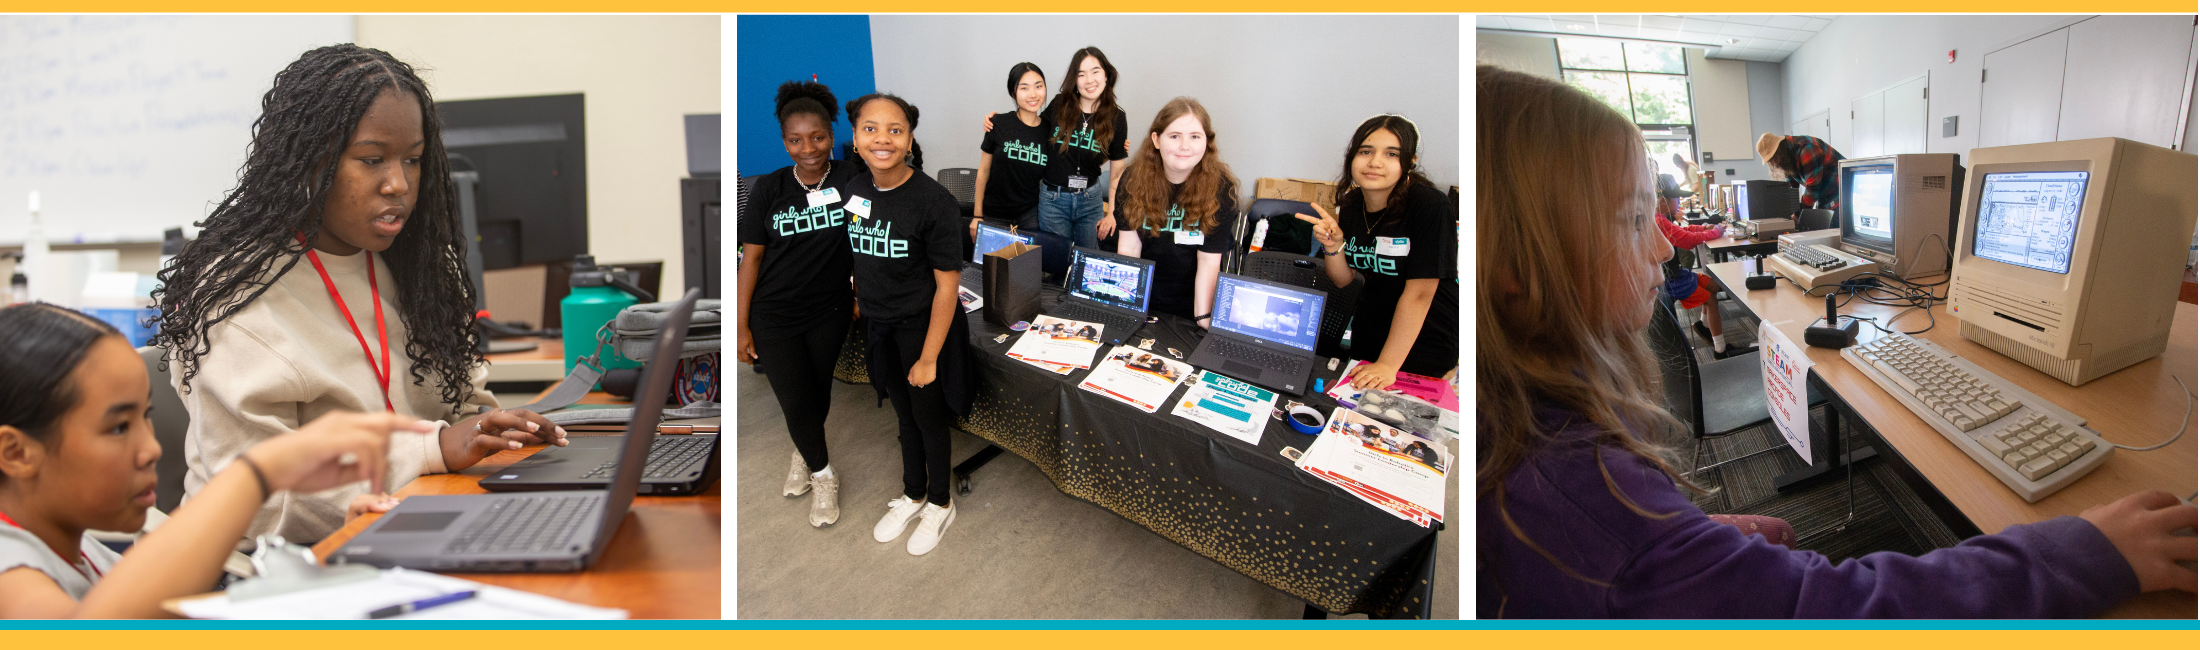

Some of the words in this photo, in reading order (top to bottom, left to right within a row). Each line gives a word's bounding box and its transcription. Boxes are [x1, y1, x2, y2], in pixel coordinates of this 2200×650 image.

[1003, 139, 1023, 153] girls
[1008, 144, 1048, 166] code
[773, 206, 799, 230] girls
[780, 205, 844, 237] code
[865, 220, 885, 237] who
[849, 221, 908, 258] code
[1767, 344, 1792, 381] STEAM
[1768, 388, 1790, 421] CONSOLES
